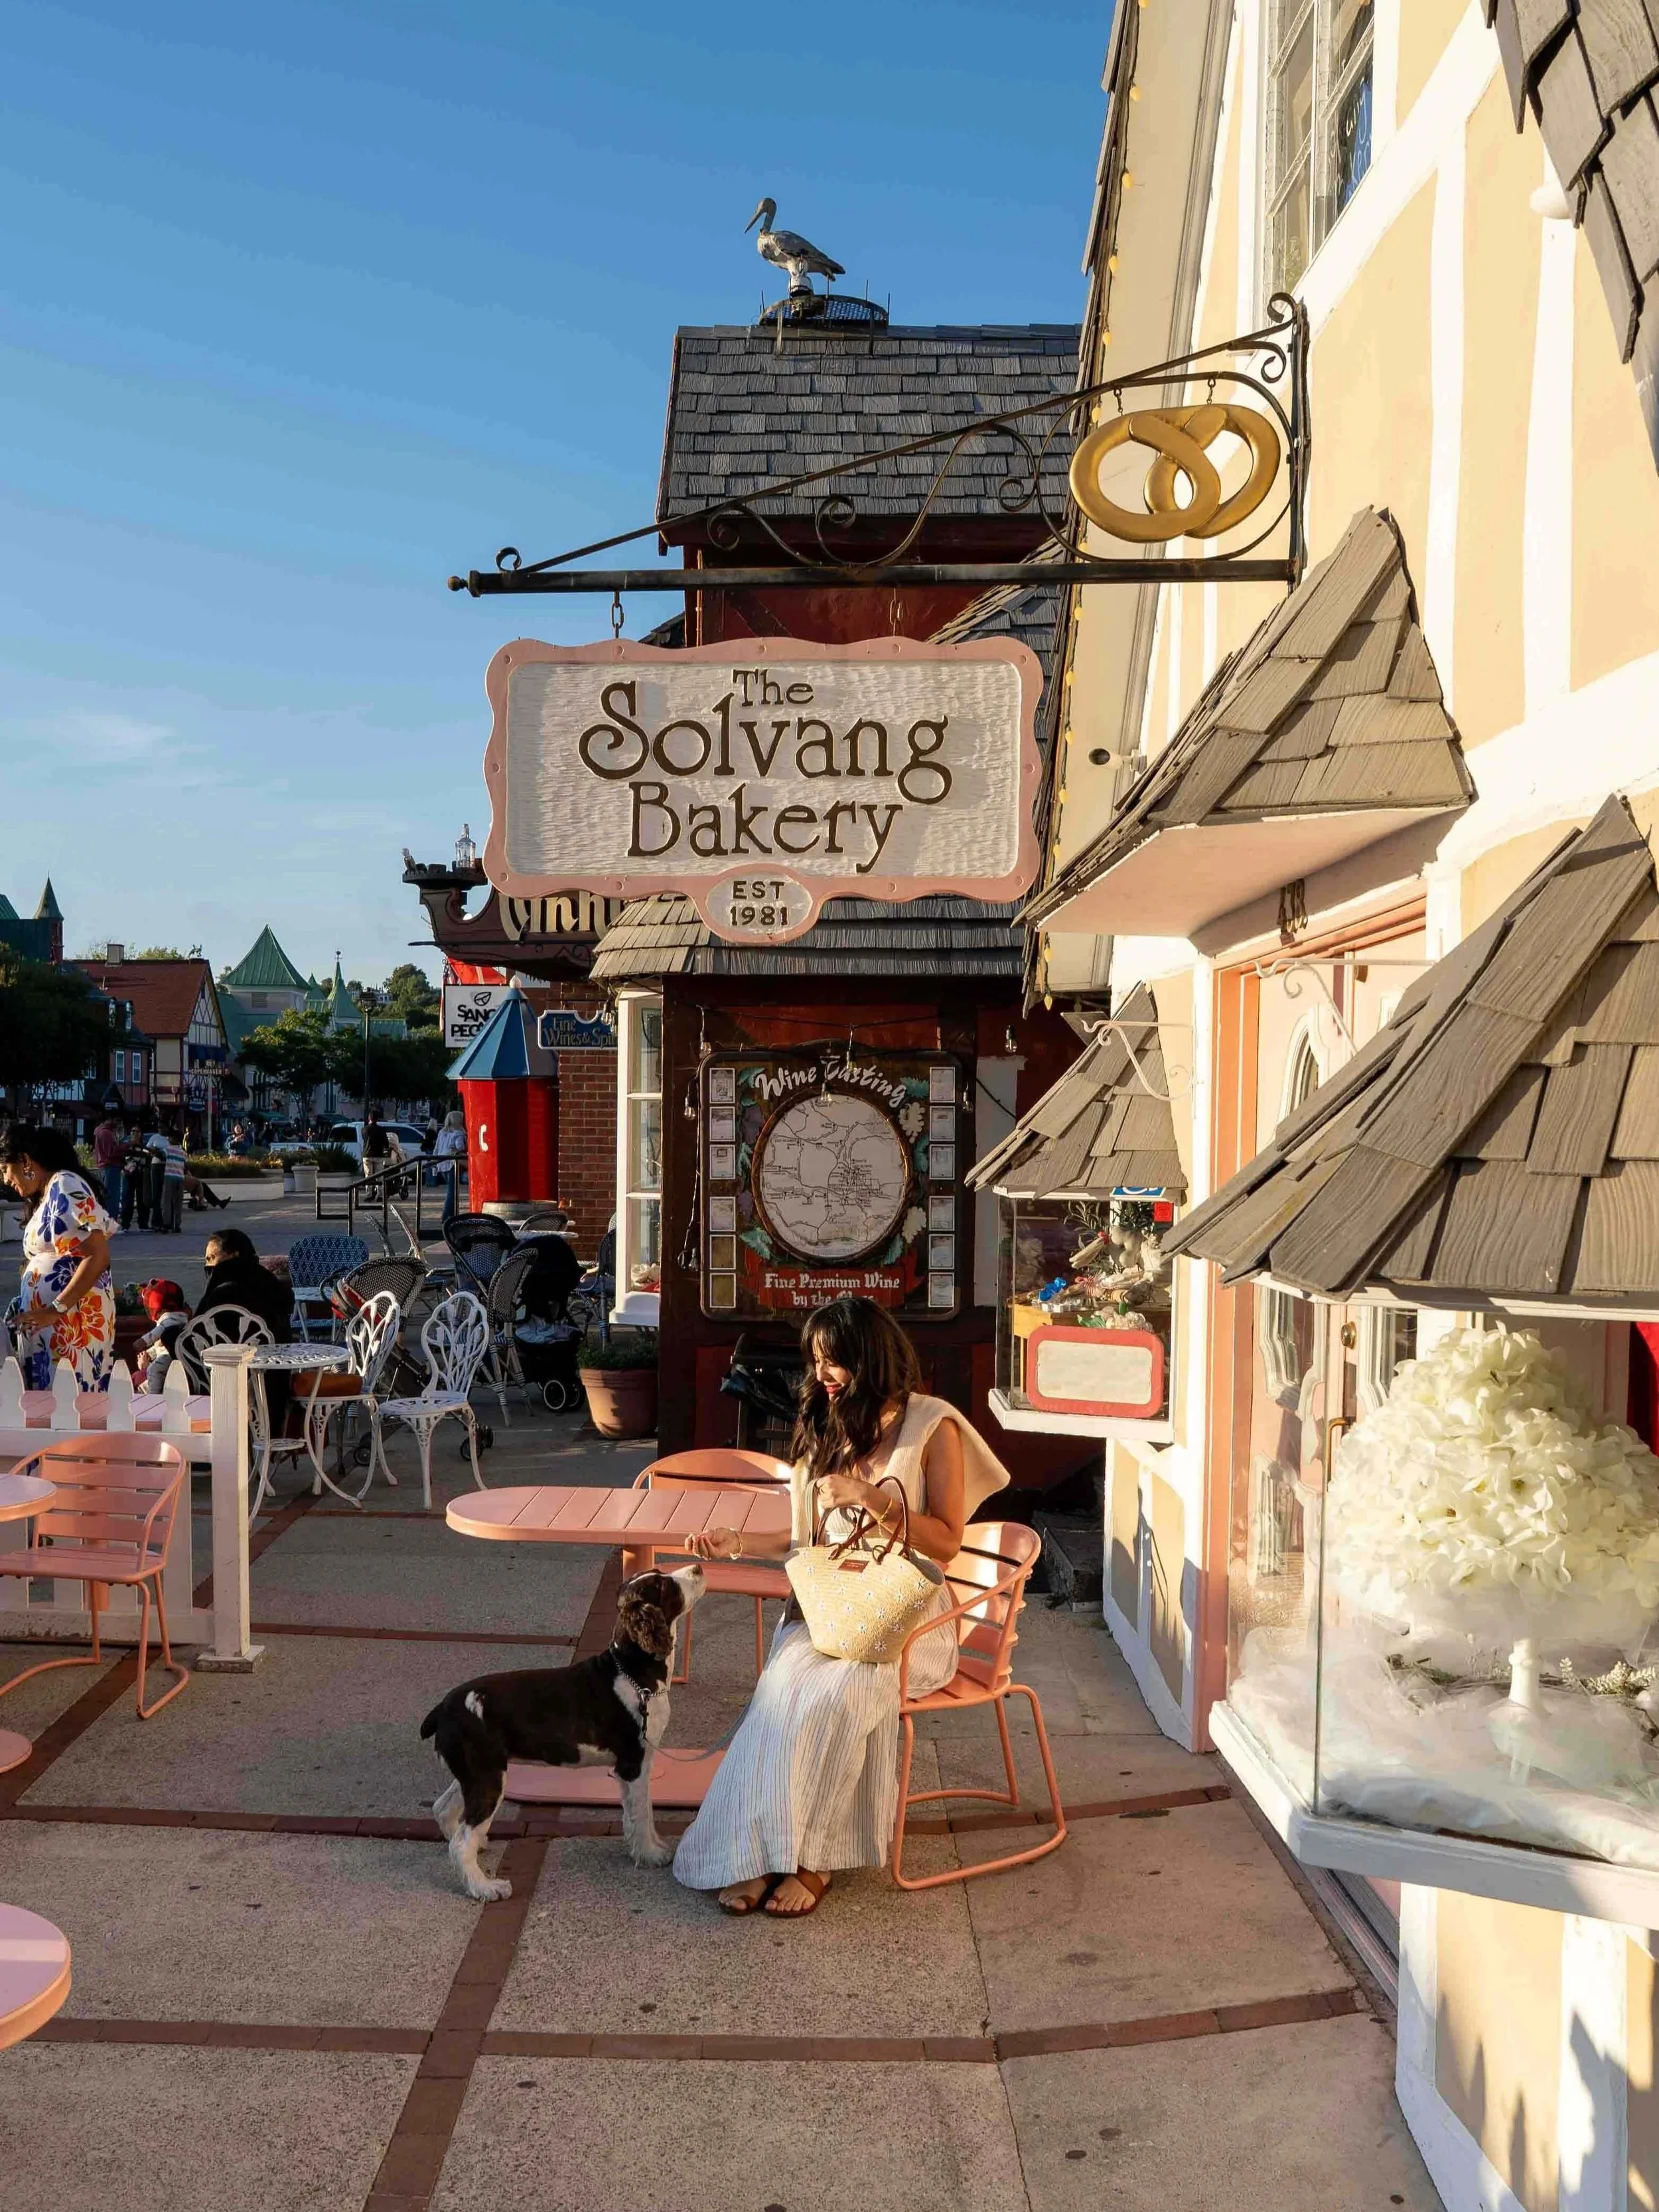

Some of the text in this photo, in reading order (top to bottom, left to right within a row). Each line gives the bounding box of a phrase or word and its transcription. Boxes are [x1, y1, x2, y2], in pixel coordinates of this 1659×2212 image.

[733, 668, 814, 707] The
[579, 680, 952, 805] Solvang
[627, 782, 903, 874] Bakery
[732, 881, 786, 899] EST
[730, 906, 788, 926] 1981
[553, 1017, 576, 1031] Fine
[541, 1027, 581, 1047] Wines
[755, 1055, 906, 1108] Wine Tasting
[764, 1272, 900, 1289] Fine Premium Wine
[791, 1290, 808, 1307] by
[810, 1290, 833, 1306] the
